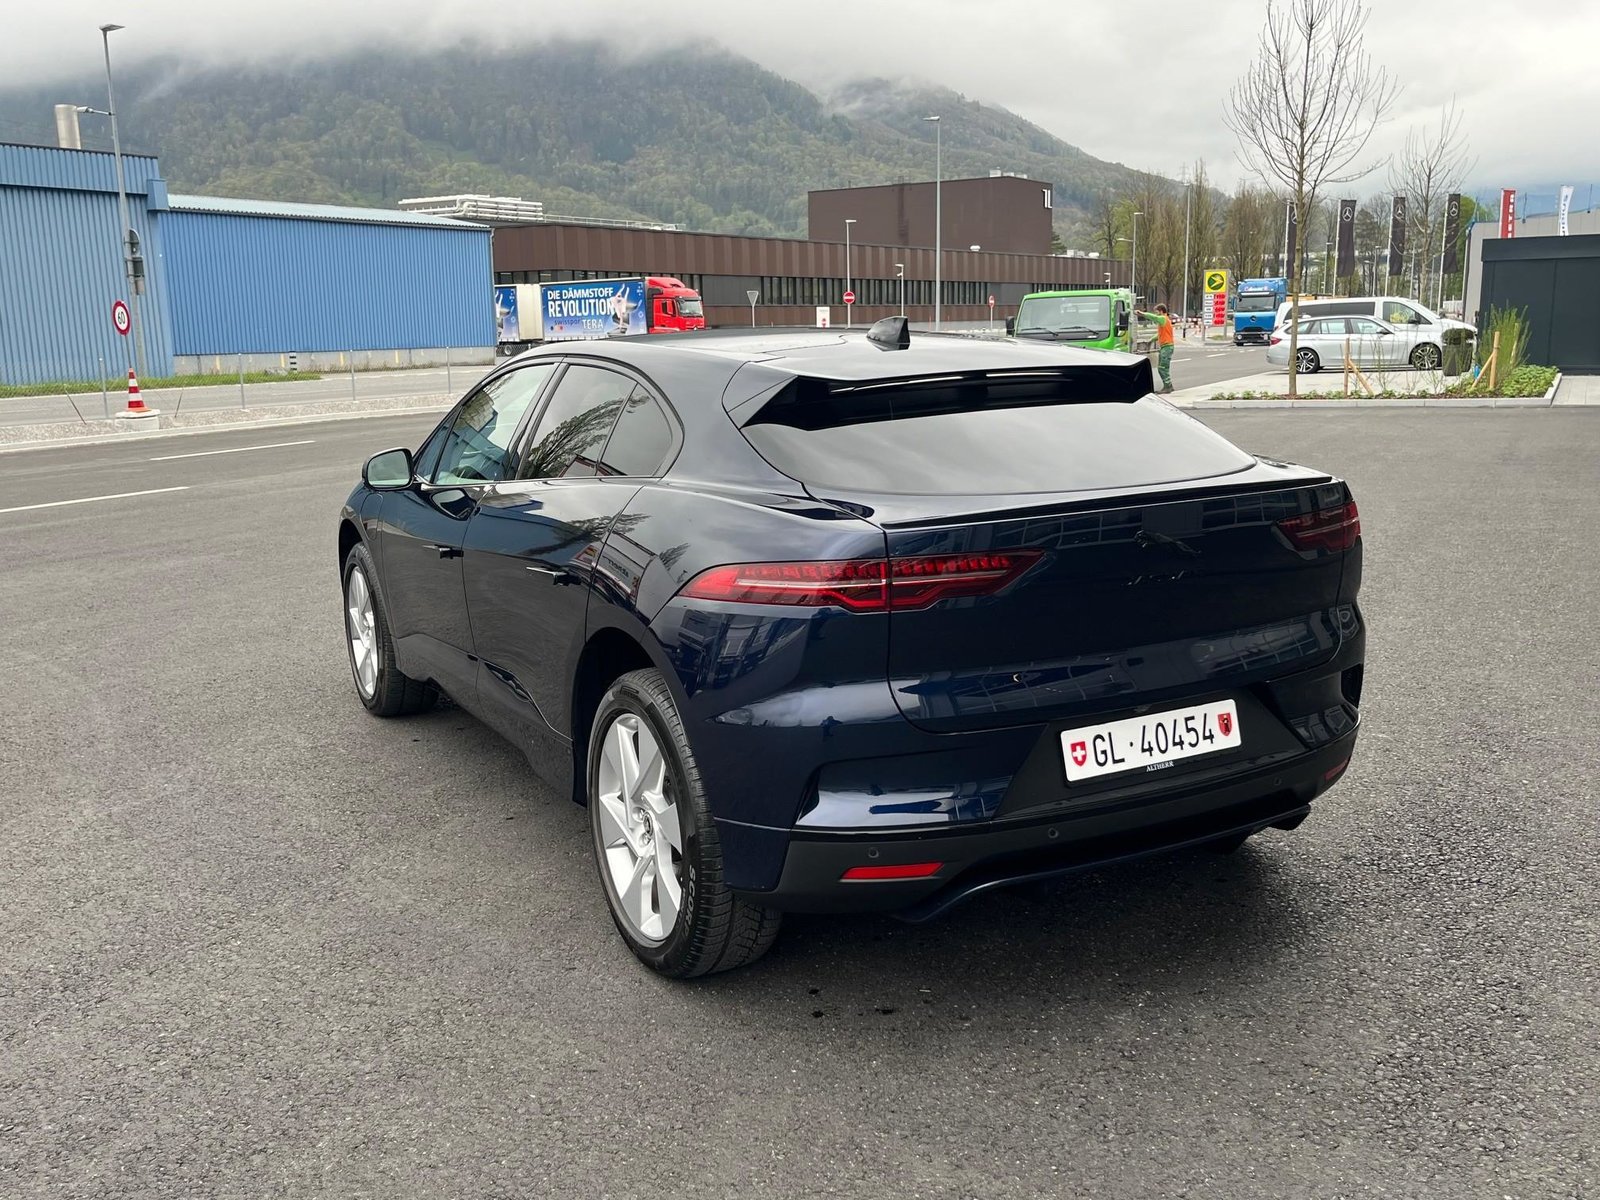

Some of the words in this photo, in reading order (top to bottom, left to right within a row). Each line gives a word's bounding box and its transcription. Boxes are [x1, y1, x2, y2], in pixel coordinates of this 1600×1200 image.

[548, 290, 561, 300] DIE
[562, 287, 613, 299] DÄMMSTOFF
[548, 298, 616, 317] REVOLUTION
[118, 311, 126, 324] 60
[582, 318, 604, 330] TERA
[1092, 732, 1125, 767] GL
[1141, 713, 1215, 757] 40454
[1146, 761, 1175, 772] ALTHERR
